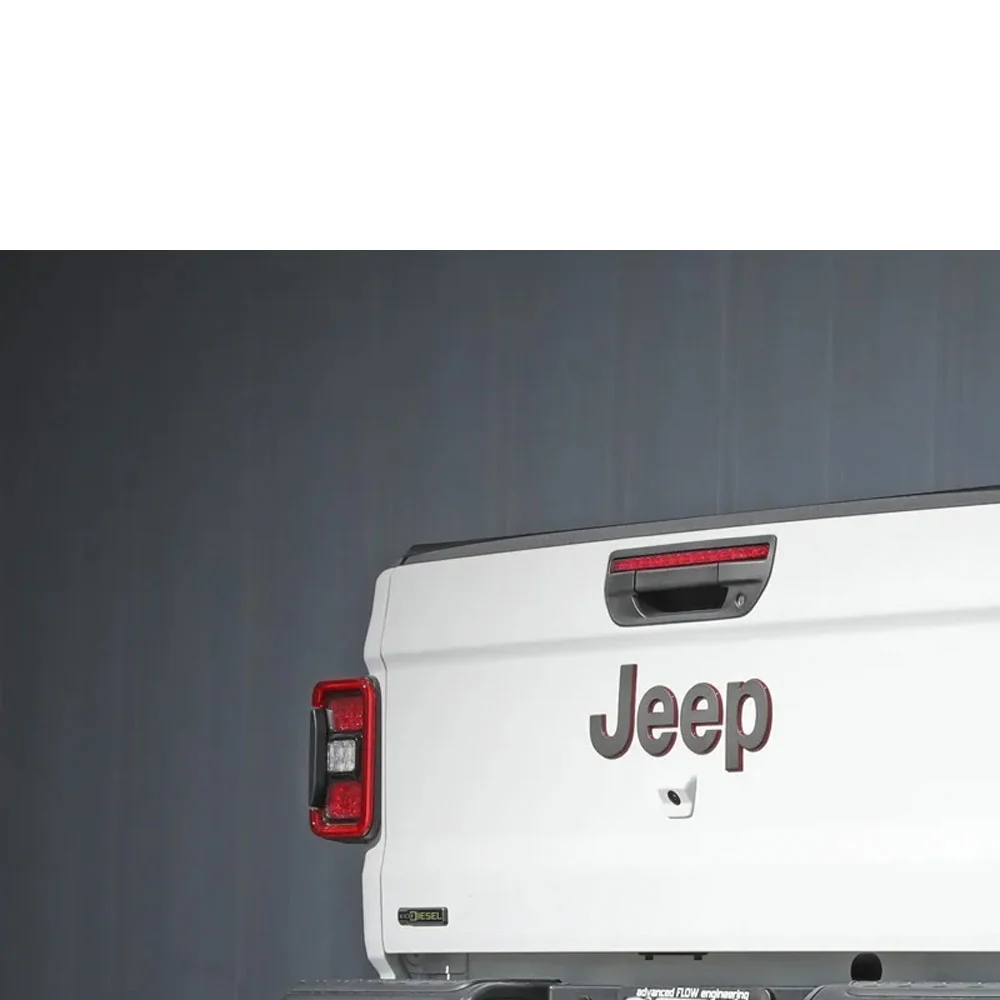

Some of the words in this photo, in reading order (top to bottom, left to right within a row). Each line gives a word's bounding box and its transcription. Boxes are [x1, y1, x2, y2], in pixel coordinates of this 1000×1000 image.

[589, 664, 773, 772] Jeep
[636, 987, 675, 997] advanced
[676, 988, 699, 998] FLOW
